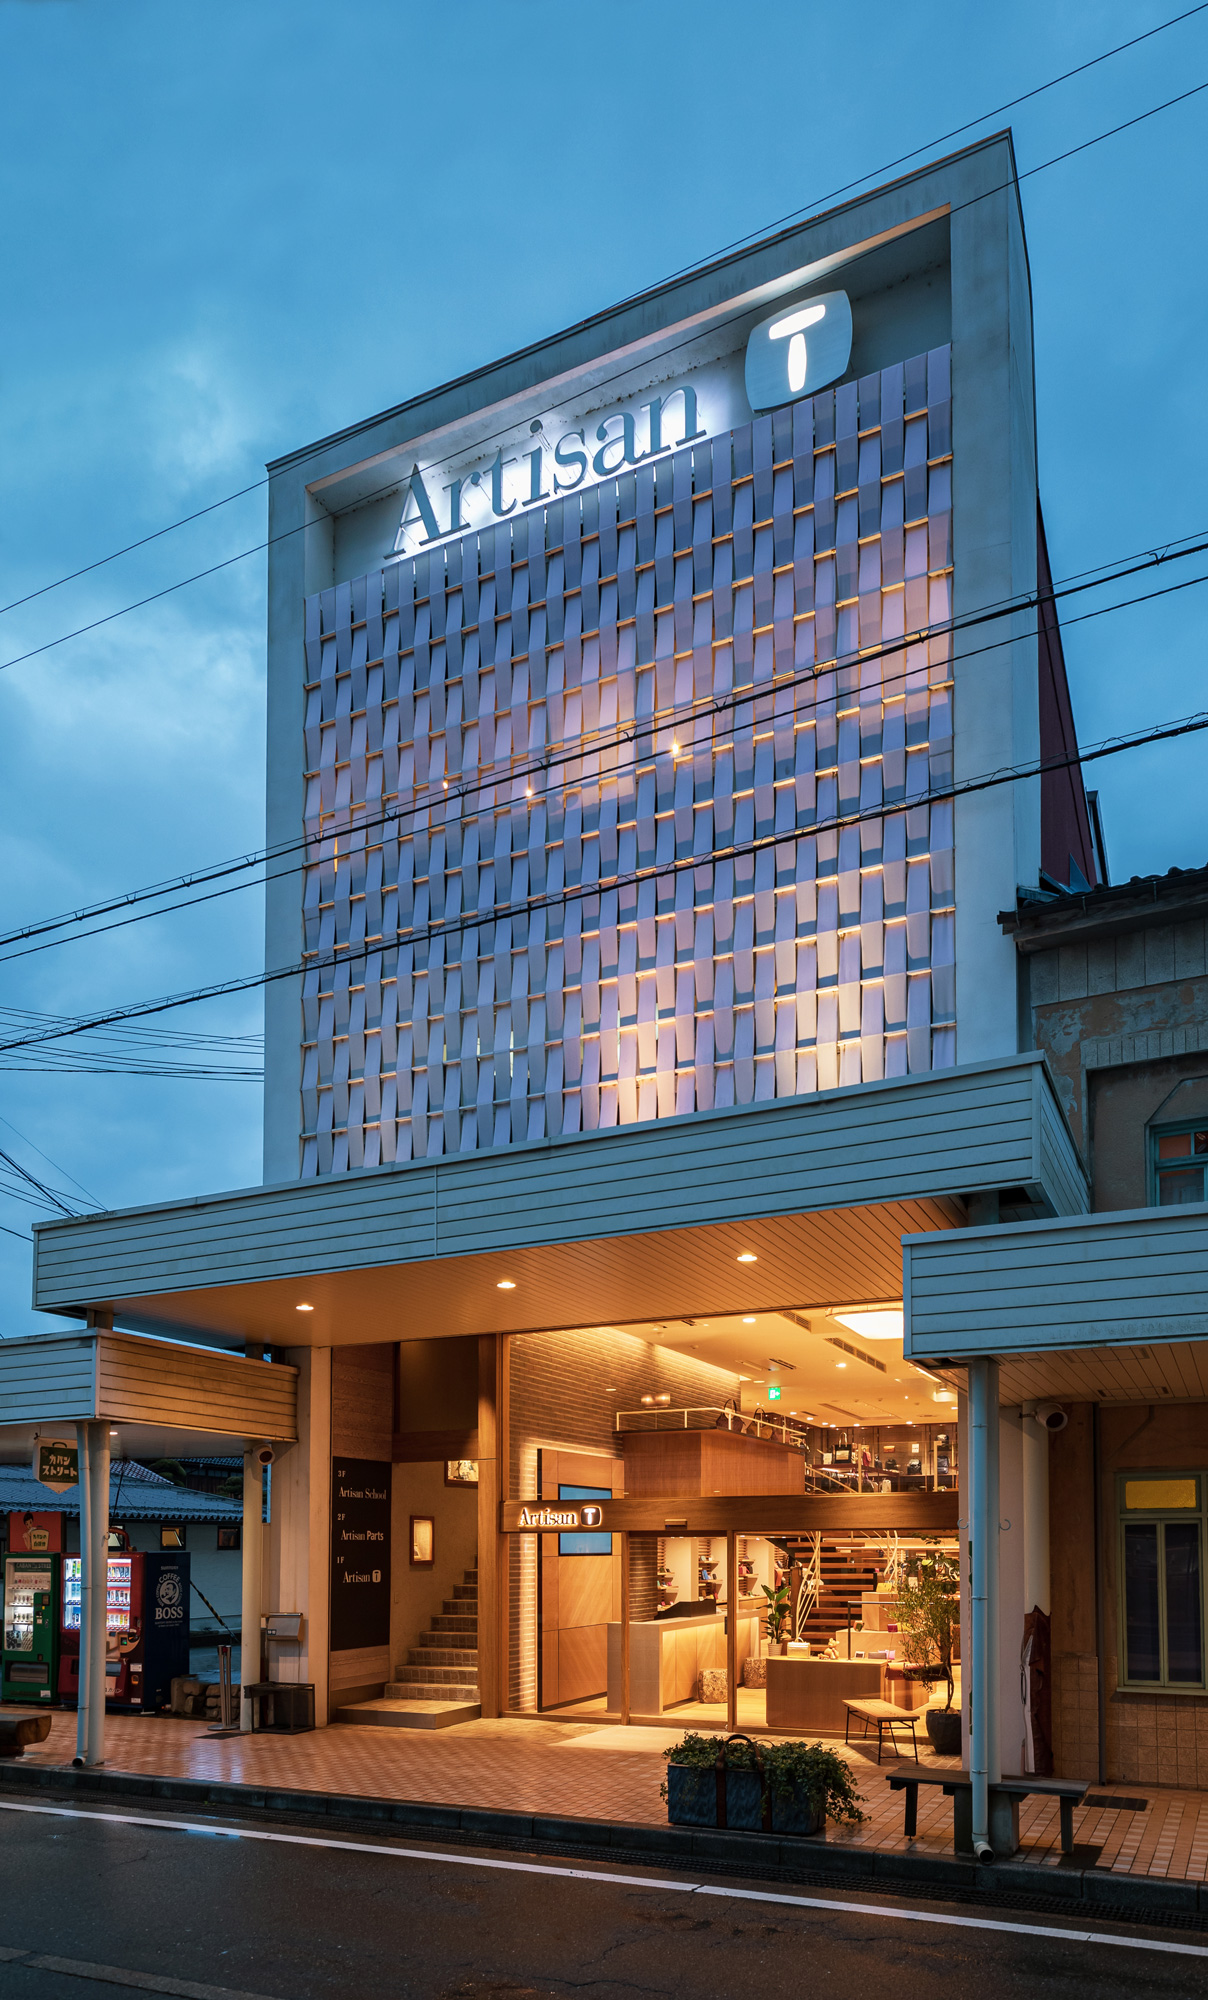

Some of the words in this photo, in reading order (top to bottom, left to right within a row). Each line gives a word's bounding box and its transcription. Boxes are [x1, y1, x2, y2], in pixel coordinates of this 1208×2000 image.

[384, 384, 706, 560] Artisan
[42, 1465, 78, 1477] ストリート
[337, 1470, 346, 1478] 3F
[338, 1486, 364, 1499] Artisan
[364, 1487, 387, 1500] School
[337, 1513, 346, 1521] 2F
[518, 1507, 578, 1527] Artisan
[340, 1529, 366, 1541] Artisan
[366, 1530, 384, 1541] Parts
[336, 1556, 345, 1564] 1F
[158, 1572, 181, 1584] COFFEE
[342, 1570, 371, 1584] Artisan
[155, 1606, 184, 1620] BOSS
